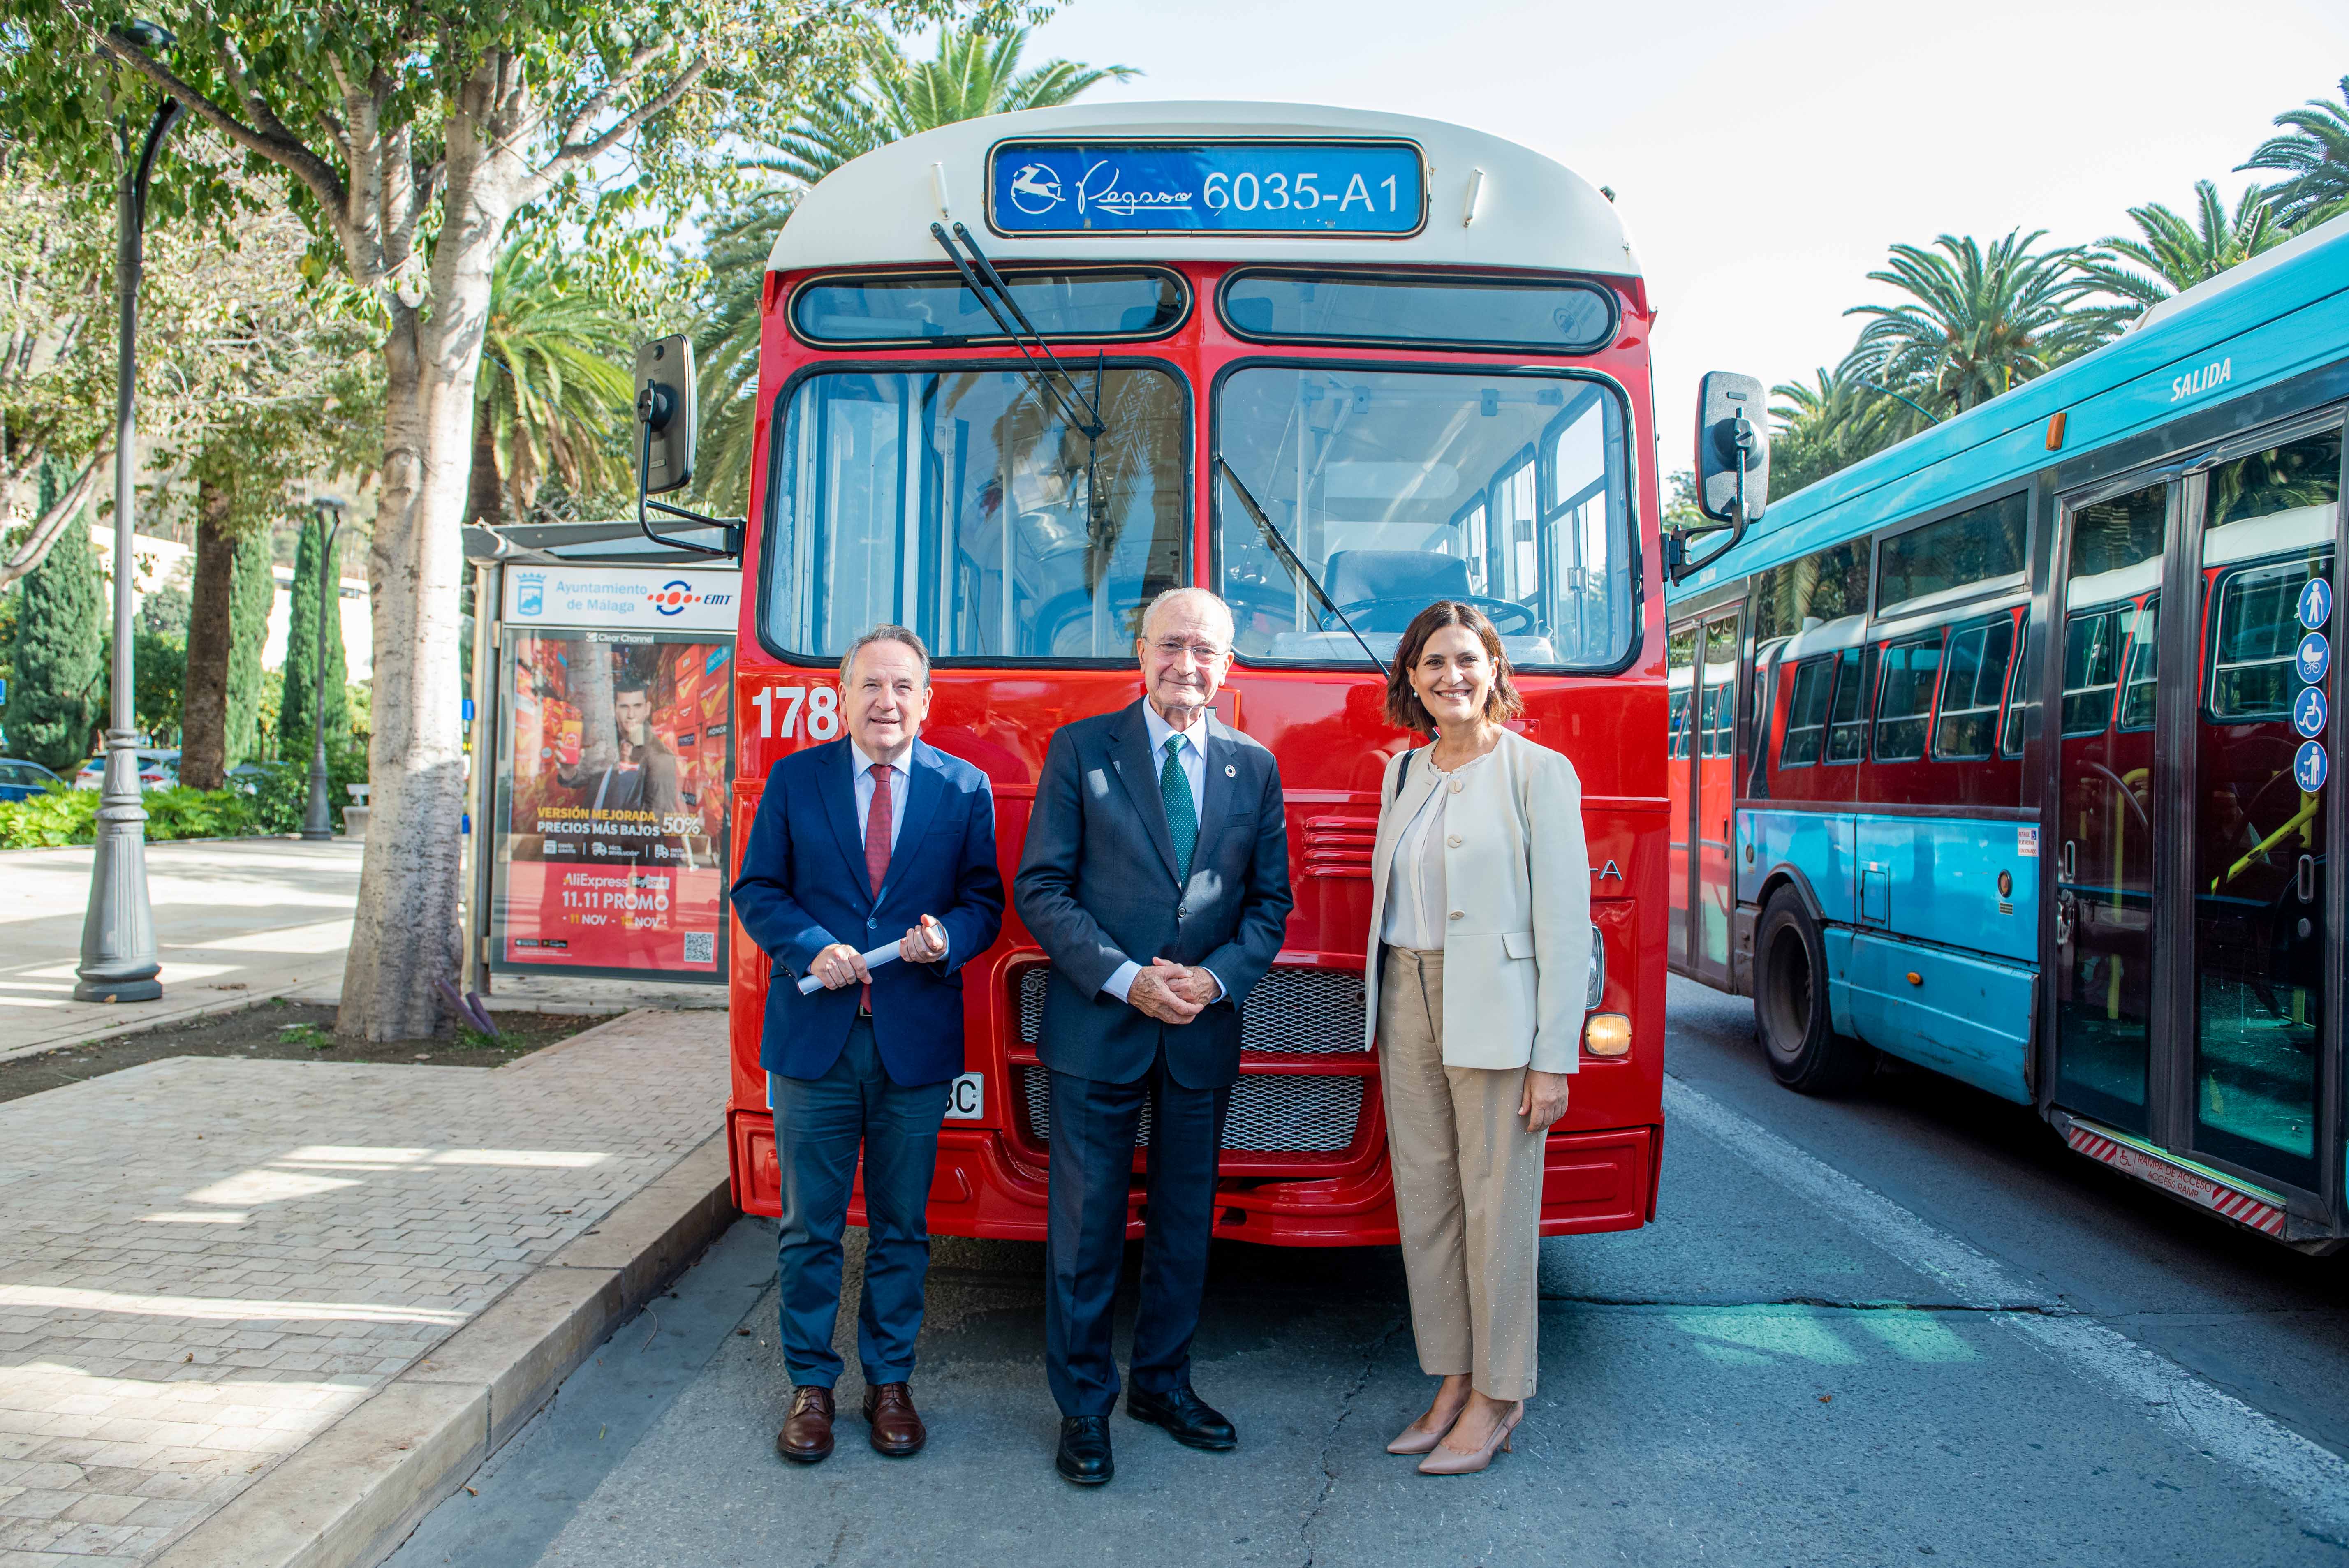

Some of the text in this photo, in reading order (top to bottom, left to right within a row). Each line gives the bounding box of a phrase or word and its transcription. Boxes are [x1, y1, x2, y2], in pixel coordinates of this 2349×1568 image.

[1075, 160, 1396, 215] Pegaso 6035-A1
[2171, 357, 2231, 402] SALIDA
[555, 580, 647, 595] Ayuntamiento
[567, 599, 635, 614] de Málaga
[704, 594, 733, 605] EMT
[598, 634, 654, 643] Clear Channel
[752, 686, 838, 740] 178
[708, 726, 727, 735] HONOR
[537, 805, 659, 822] VERSIÓN MEJORADA,
[537, 821, 660, 837] PRECIOS MÁS BAJOS
[661, 816, 701, 835] 50%
[563, 872, 629, 890] AliExpress
[562, 891, 669, 911] 11.11 PROMO
[570, 914, 580, 924] 11
[582, 914, 607, 926] NOV
[634, 916, 660, 928] NOV
[2138, 1154, 2212, 1193] RAMPA DE ACCESO
[2147, 1170, 2199, 1198] ACCESS RAMP
